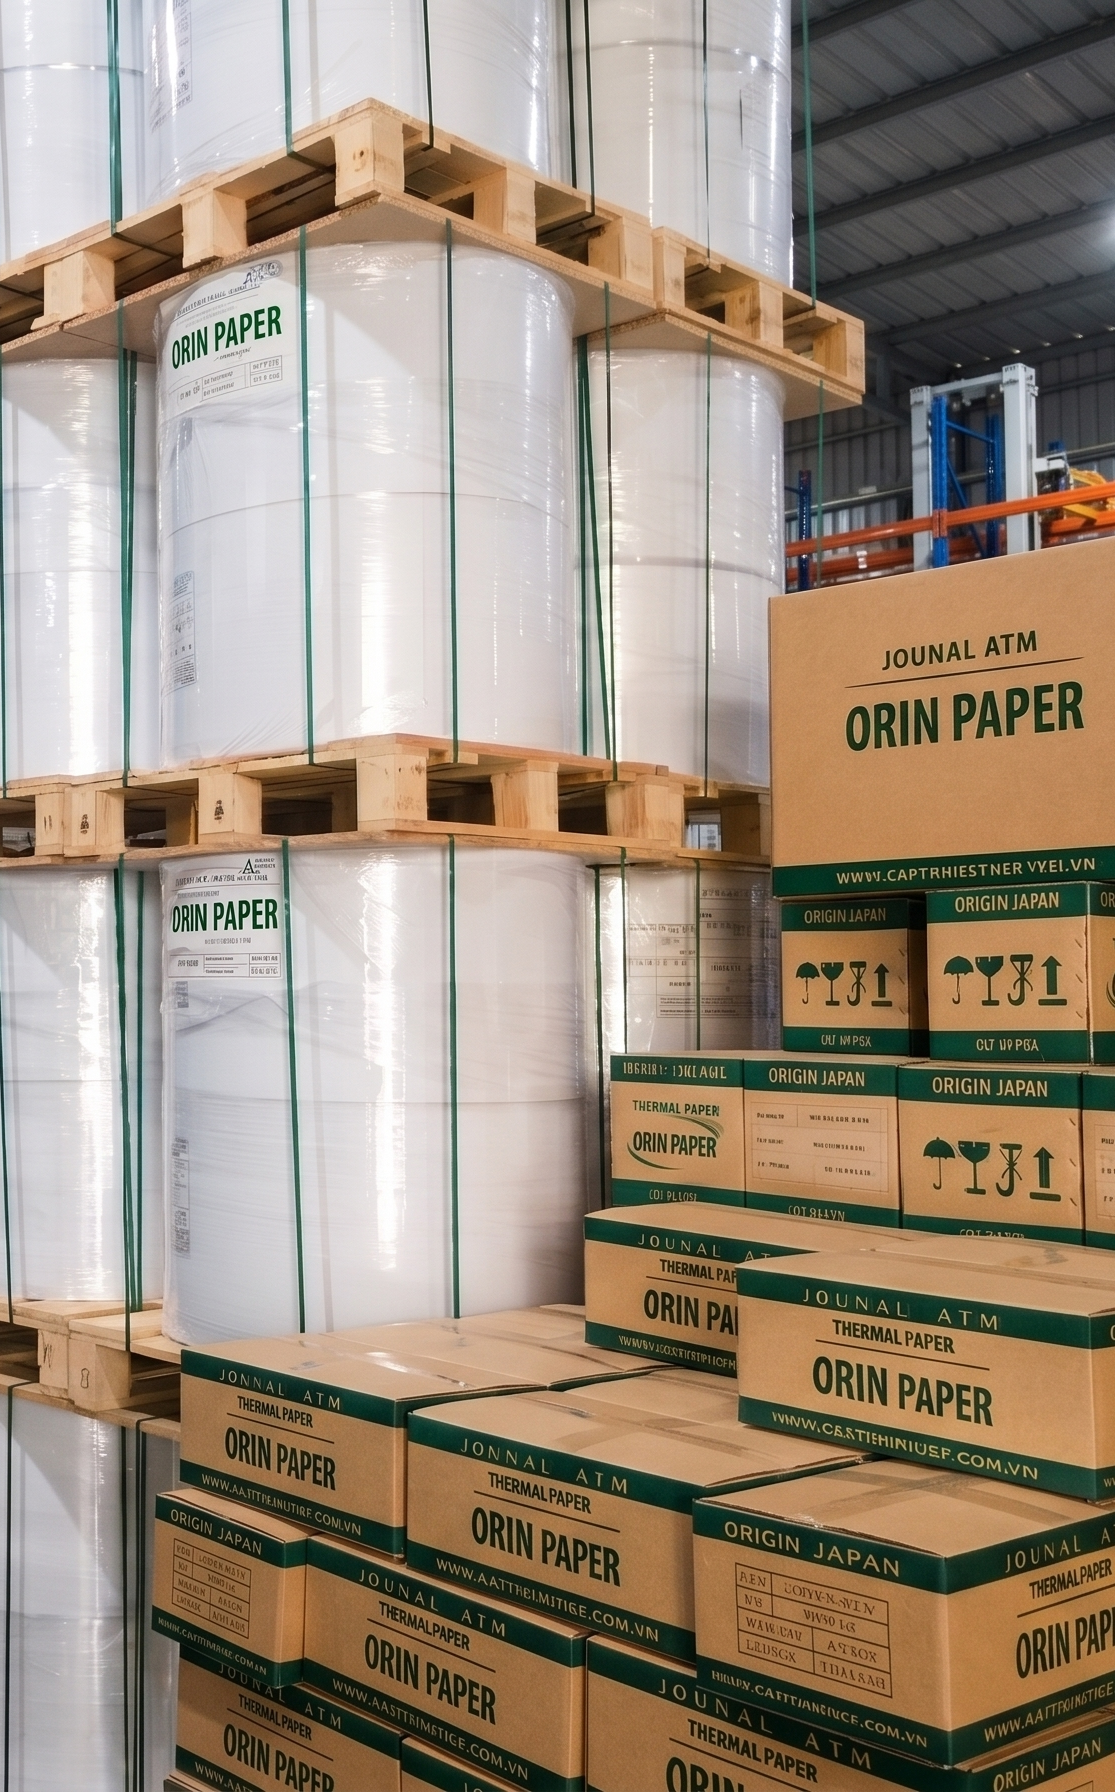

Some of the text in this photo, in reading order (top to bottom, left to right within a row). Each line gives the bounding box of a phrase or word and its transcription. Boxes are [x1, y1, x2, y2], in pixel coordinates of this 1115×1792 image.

[171, 305, 282, 370] ORIN PAPER
[882, 630, 1038, 671] JOUNAL ATM
[845, 680, 1085, 752] ORIN PAPER
[172, 898, 278, 933] ORIN PAPER
[803, 907, 886, 924] ORIGIN JAPAN
[954, 891, 1060, 913] ORIGIN JAPAN
[768, 1067, 865, 1087] ORIGIN JAPAN
[932, 1076, 1048, 1098] ORIGIN JAPAN
[632, 1099, 720, 1117] THERMAL PAPER
[632, 1130, 717, 1158] ORIN PAPER
[637, 1233, 722, 1258] JOUNAL
[659, 1258, 715, 1281] THERMAL
[643, 1289, 700, 1329] ORIN
[803, 1288, 999, 1331] JOUNAL ATM
[832, 1318, 956, 1354] THERMAL PAPER
[237, 1395, 314, 1429] THERMAL PAPER
[303, 1389, 341, 1411] ATM
[812, 1355, 994, 1427] ORIN PAPER
[224, 1426, 336, 1491] ORIN PAPER
[487, 1470, 592, 1515] THERMAL PAPER
[575, 1467, 628, 1495] ATM
[170, 1508, 262, 1556] ORIGIN JAPAN
[471, 1506, 621, 1588] ORIN PAPER
[724, 1521, 900, 1578] ORIGIN JAPAN
[1004, 1534, 1082, 1574] JOUNAL
[1029, 1557, 1113, 1600] THERMAL PAPER
[358, 1569, 506, 1638] JOUNAL ATM
[378, 1600, 471, 1652] THERMAL PAPER
[1015, 1606, 1115, 1680] ORIN PAP
[364, 1633, 497, 1726] ORIN PAPER
[238, 1693, 313, 1741] THERMAL PAPER
[304, 1702, 342, 1730] ATM
[658, 1678, 872, 1770] JOUNAL ATM
[223, 1723, 270, 1776] ORIN
[687, 1718, 819, 1784] THERMAL PAPER
[993, 1736, 1102, 1792] ORIGIN JAPAN
